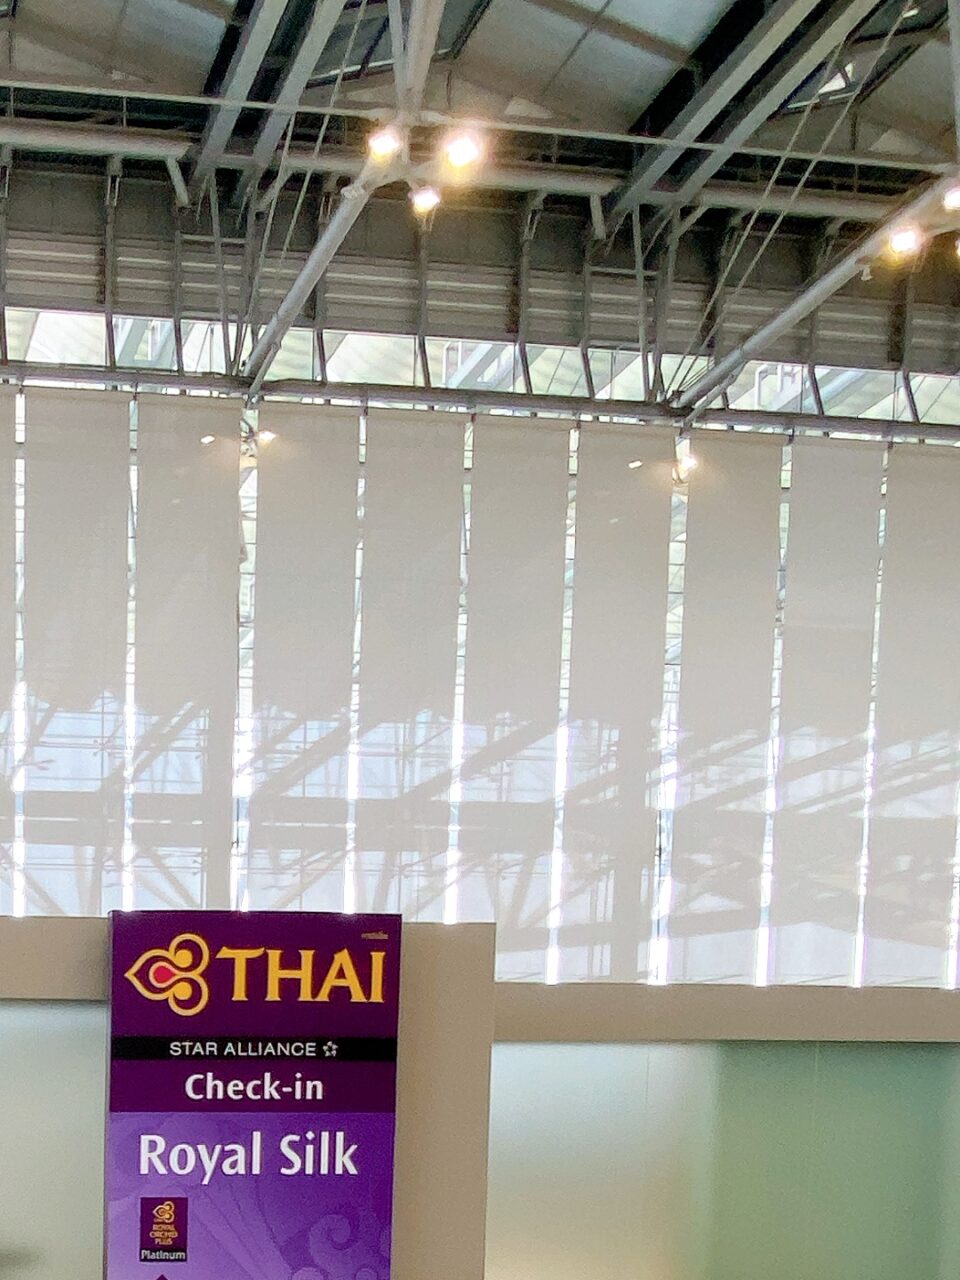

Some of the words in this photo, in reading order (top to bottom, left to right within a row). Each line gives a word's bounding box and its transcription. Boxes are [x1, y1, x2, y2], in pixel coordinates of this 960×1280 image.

[215, 946, 386, 1003] THAI
[169, 1041, 218, 1056] STAR
[223, 1041, 317, 1057] ALLIANCE
[185, 1071, 324, 1100] Check-in
[139, 1131, 261, 1185] Royal
[280, 1130, 358, 1175] Silk
[141, 1249, 186, 1260] Platinum
